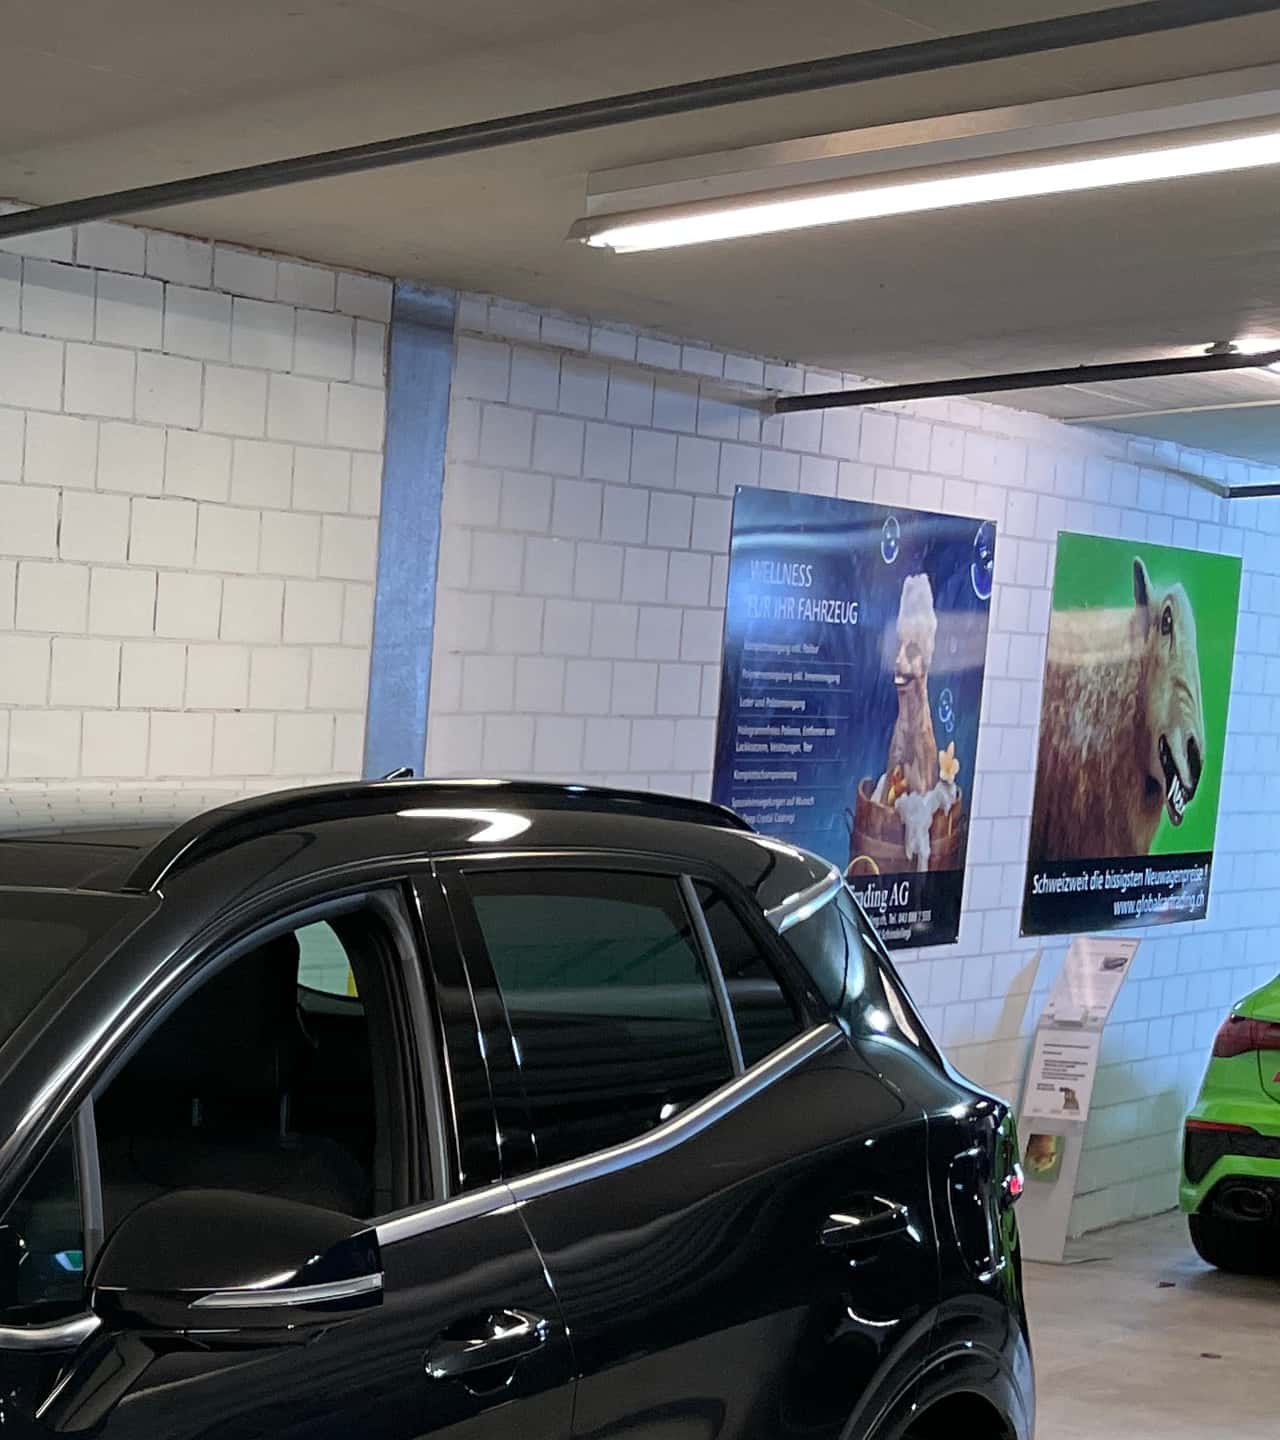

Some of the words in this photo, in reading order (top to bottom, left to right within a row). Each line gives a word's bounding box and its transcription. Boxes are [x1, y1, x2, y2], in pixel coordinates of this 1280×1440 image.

[750, 559, 813, 588] WELLNESS
[774, 596, 795, 620] IHR
[797, 598, 859, 625] FAHRZEUG
[889, 881, 910, 907] AG
[1032, 871, 1090, 895] Schweizweit
[1090, 869, 1104, 890] die
[1104, 868, 1144, 893] bissigsten
